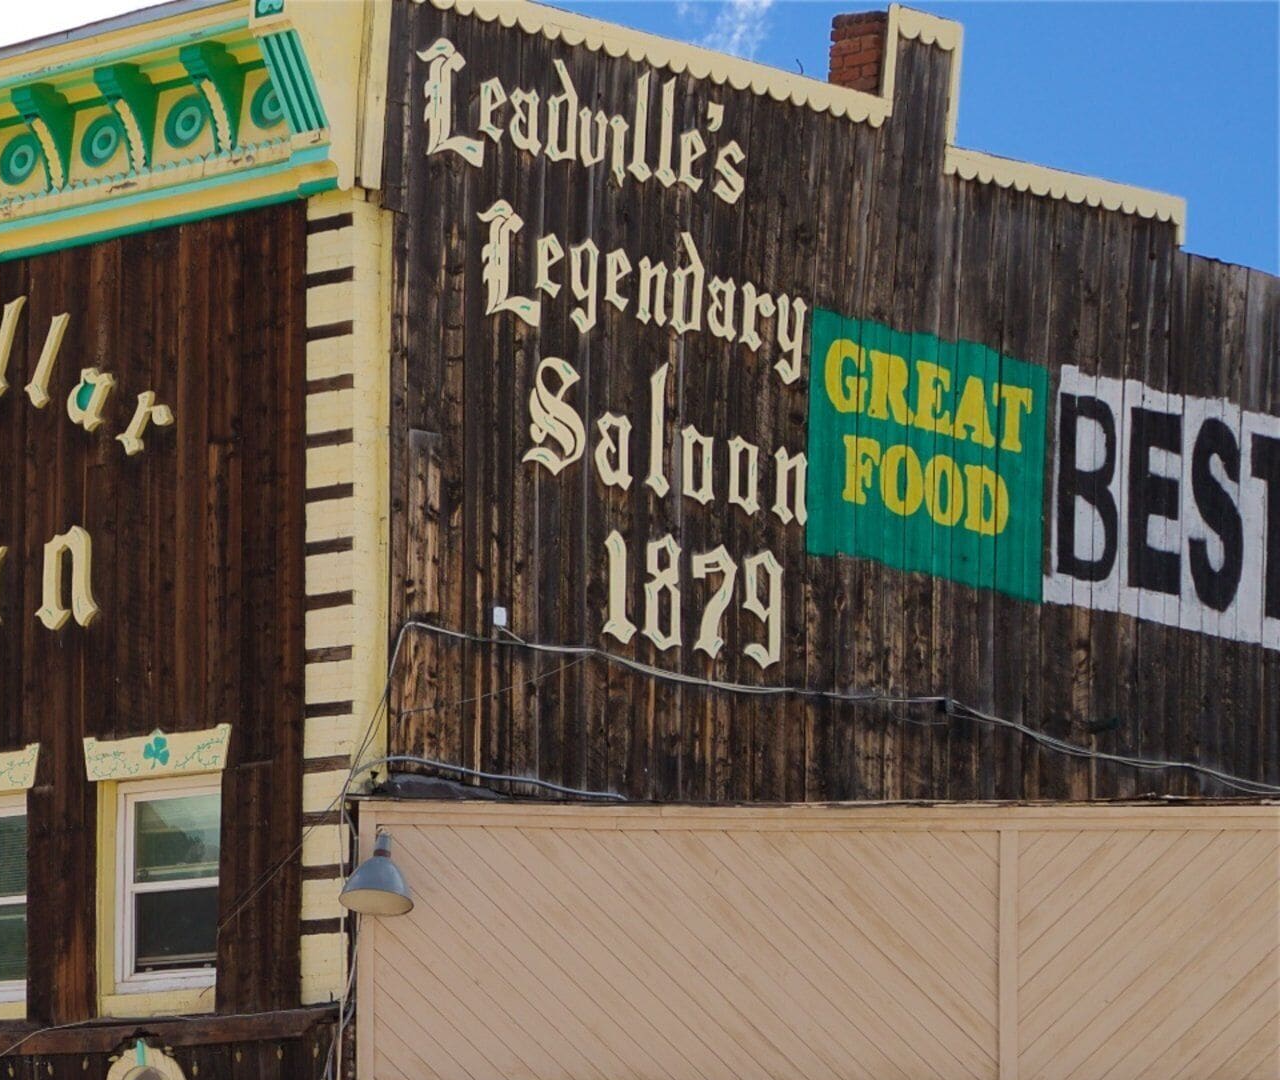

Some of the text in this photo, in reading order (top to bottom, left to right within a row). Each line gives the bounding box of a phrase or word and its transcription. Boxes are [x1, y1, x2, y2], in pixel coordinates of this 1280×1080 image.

[416, 38, 746, 204] Leadville's
[476, 199, 807, 385] Legendary
[522, 356, 808, 524] Saloon
[825, 339, 1032, 452] GREAT
[842, 434, 1009, 536] FOOD
[603, 530, 785, 669] 1879
